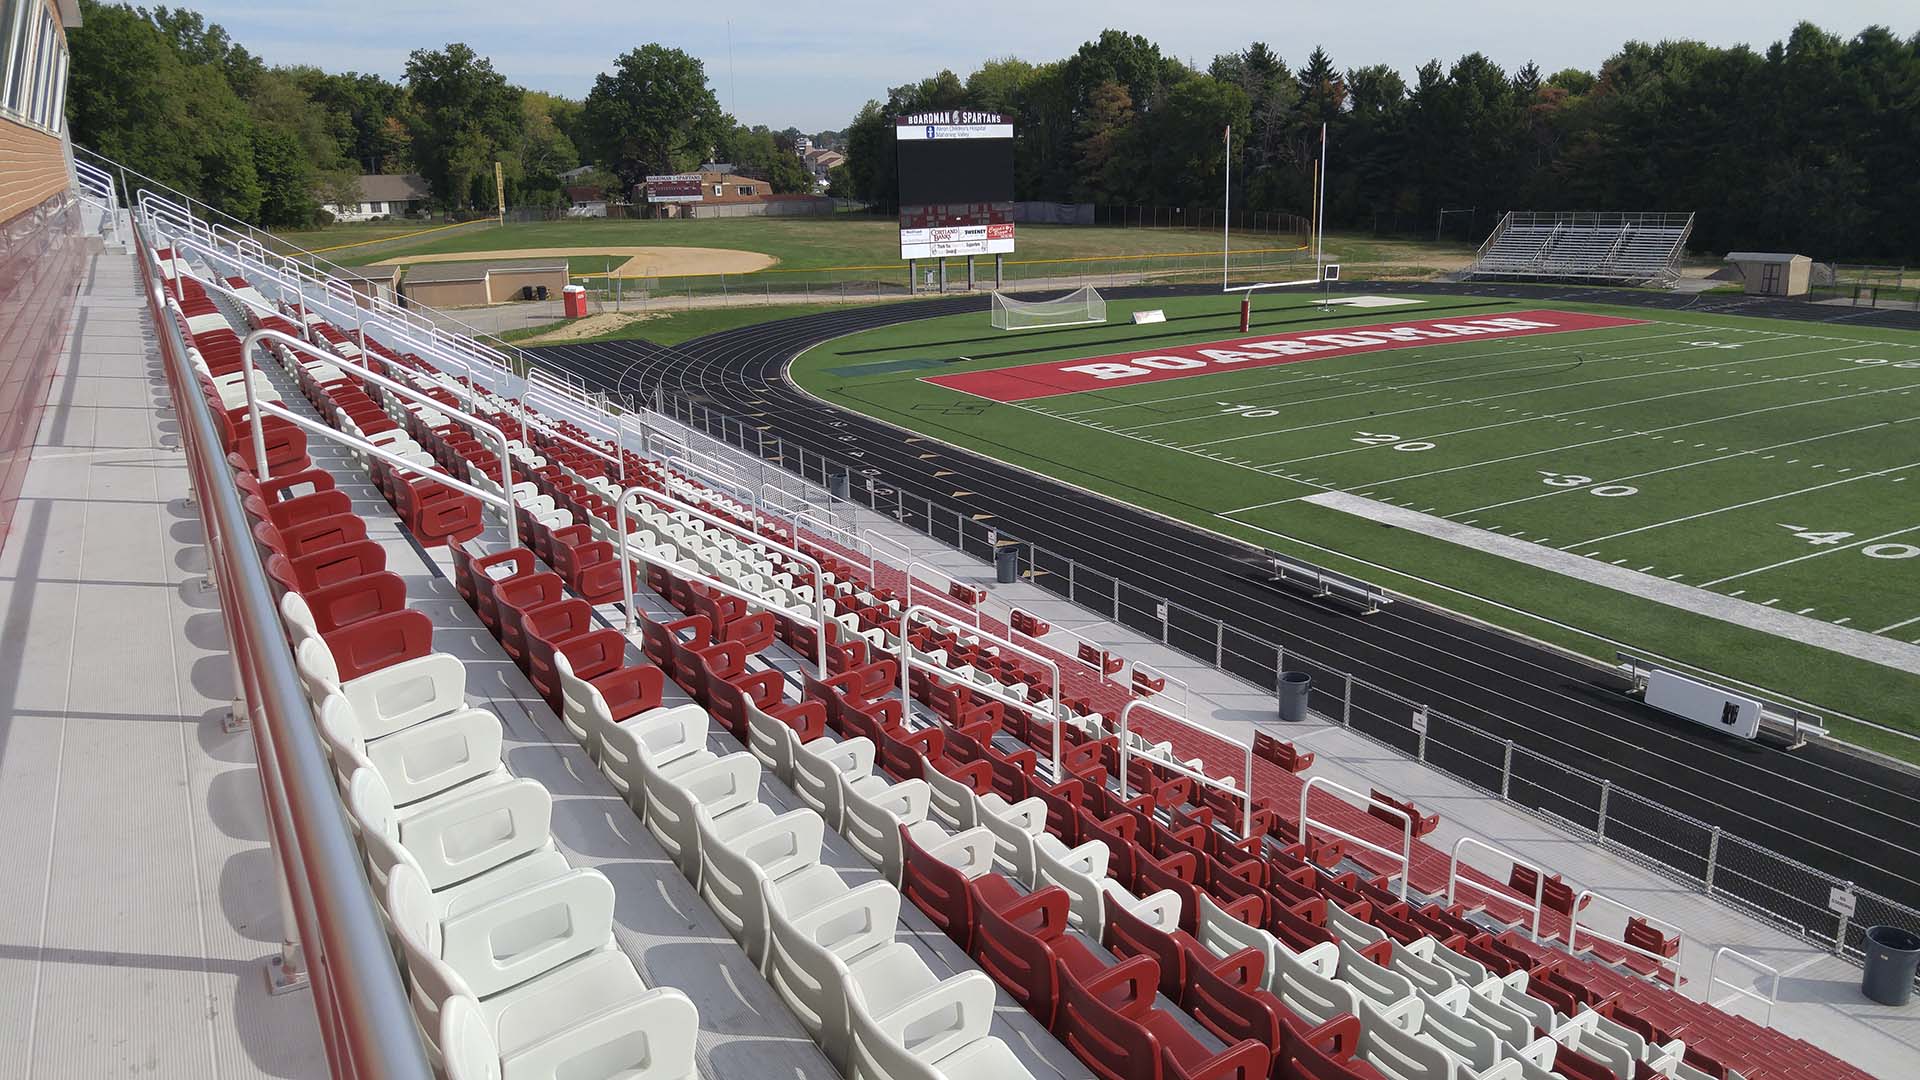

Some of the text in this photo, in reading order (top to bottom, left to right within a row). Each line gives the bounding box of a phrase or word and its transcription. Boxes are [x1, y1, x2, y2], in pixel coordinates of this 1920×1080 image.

[908, 111, 1001, 124] BOARDMAN SPARTANS
[1059, 317, 1561, 380] BOARDMAN
[1220, 404, 1280, 418] 10
[1352, 433, 1437, 452] 20
[1543, 474, 1639, 497] 30
[1793, 531, 1920, 559] 40
